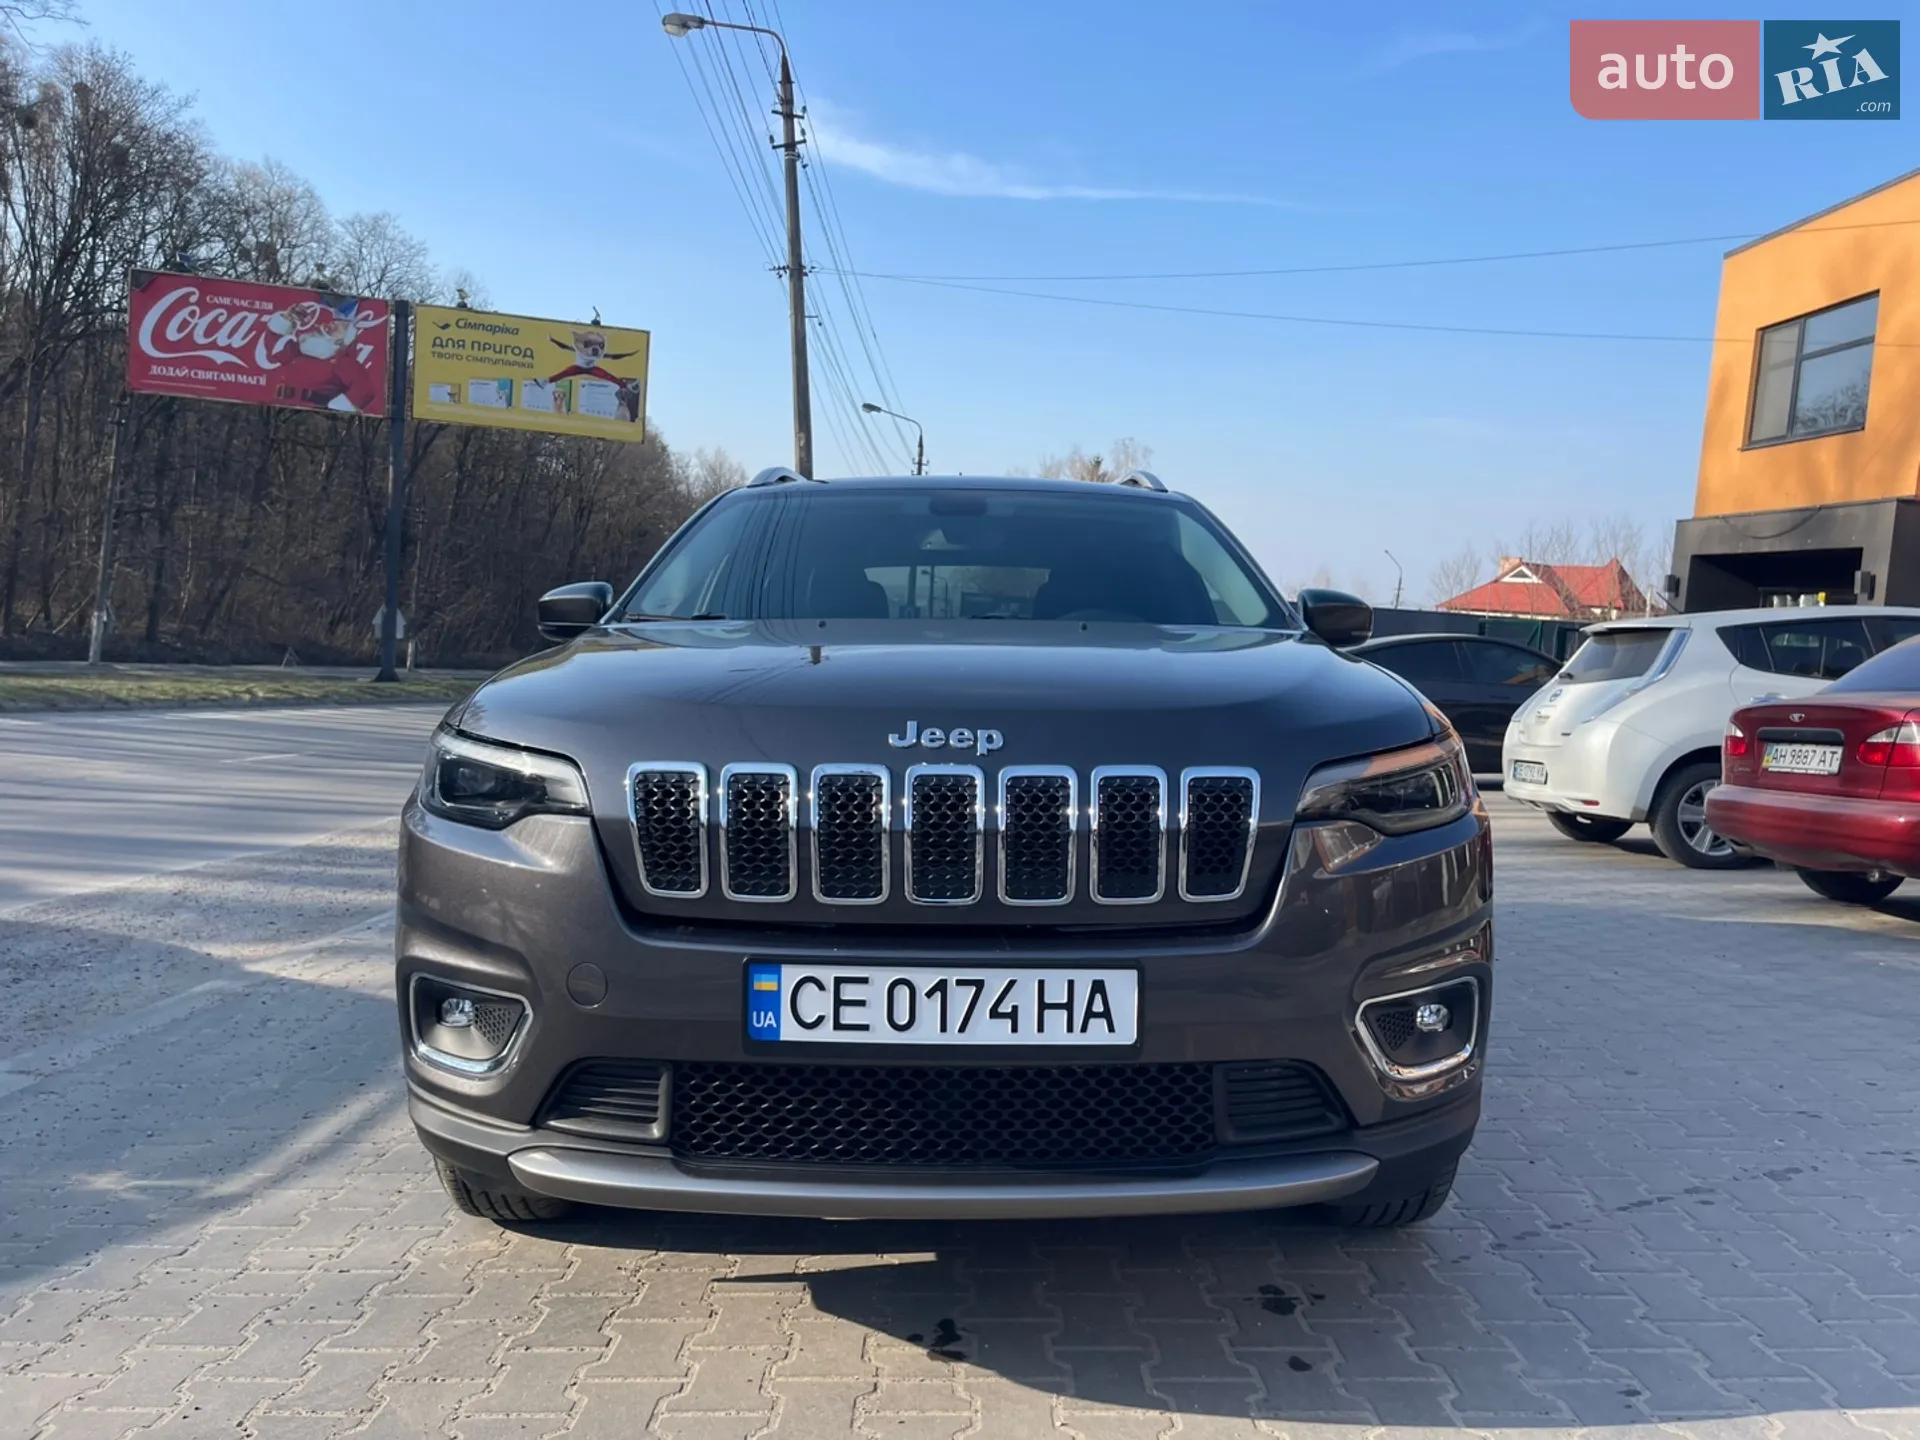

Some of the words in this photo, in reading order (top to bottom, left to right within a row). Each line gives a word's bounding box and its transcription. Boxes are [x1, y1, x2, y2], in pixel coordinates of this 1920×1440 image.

[455, 317, 520, 336] Сімпаріка
[148, 365, 189, 377] ДОДАЙ
[190, 369, 236, 383] СВЯТАМ
[888, 720, 1004, 756] Jeep
[1789, 748, 1817, 766] 9887
[789, 974, 870, 1032] CE
[885, 977, 1019, 1034] 0174
[1036, 978, 1116, 1034] HA
[753, 1011, 777, 1028] UA
